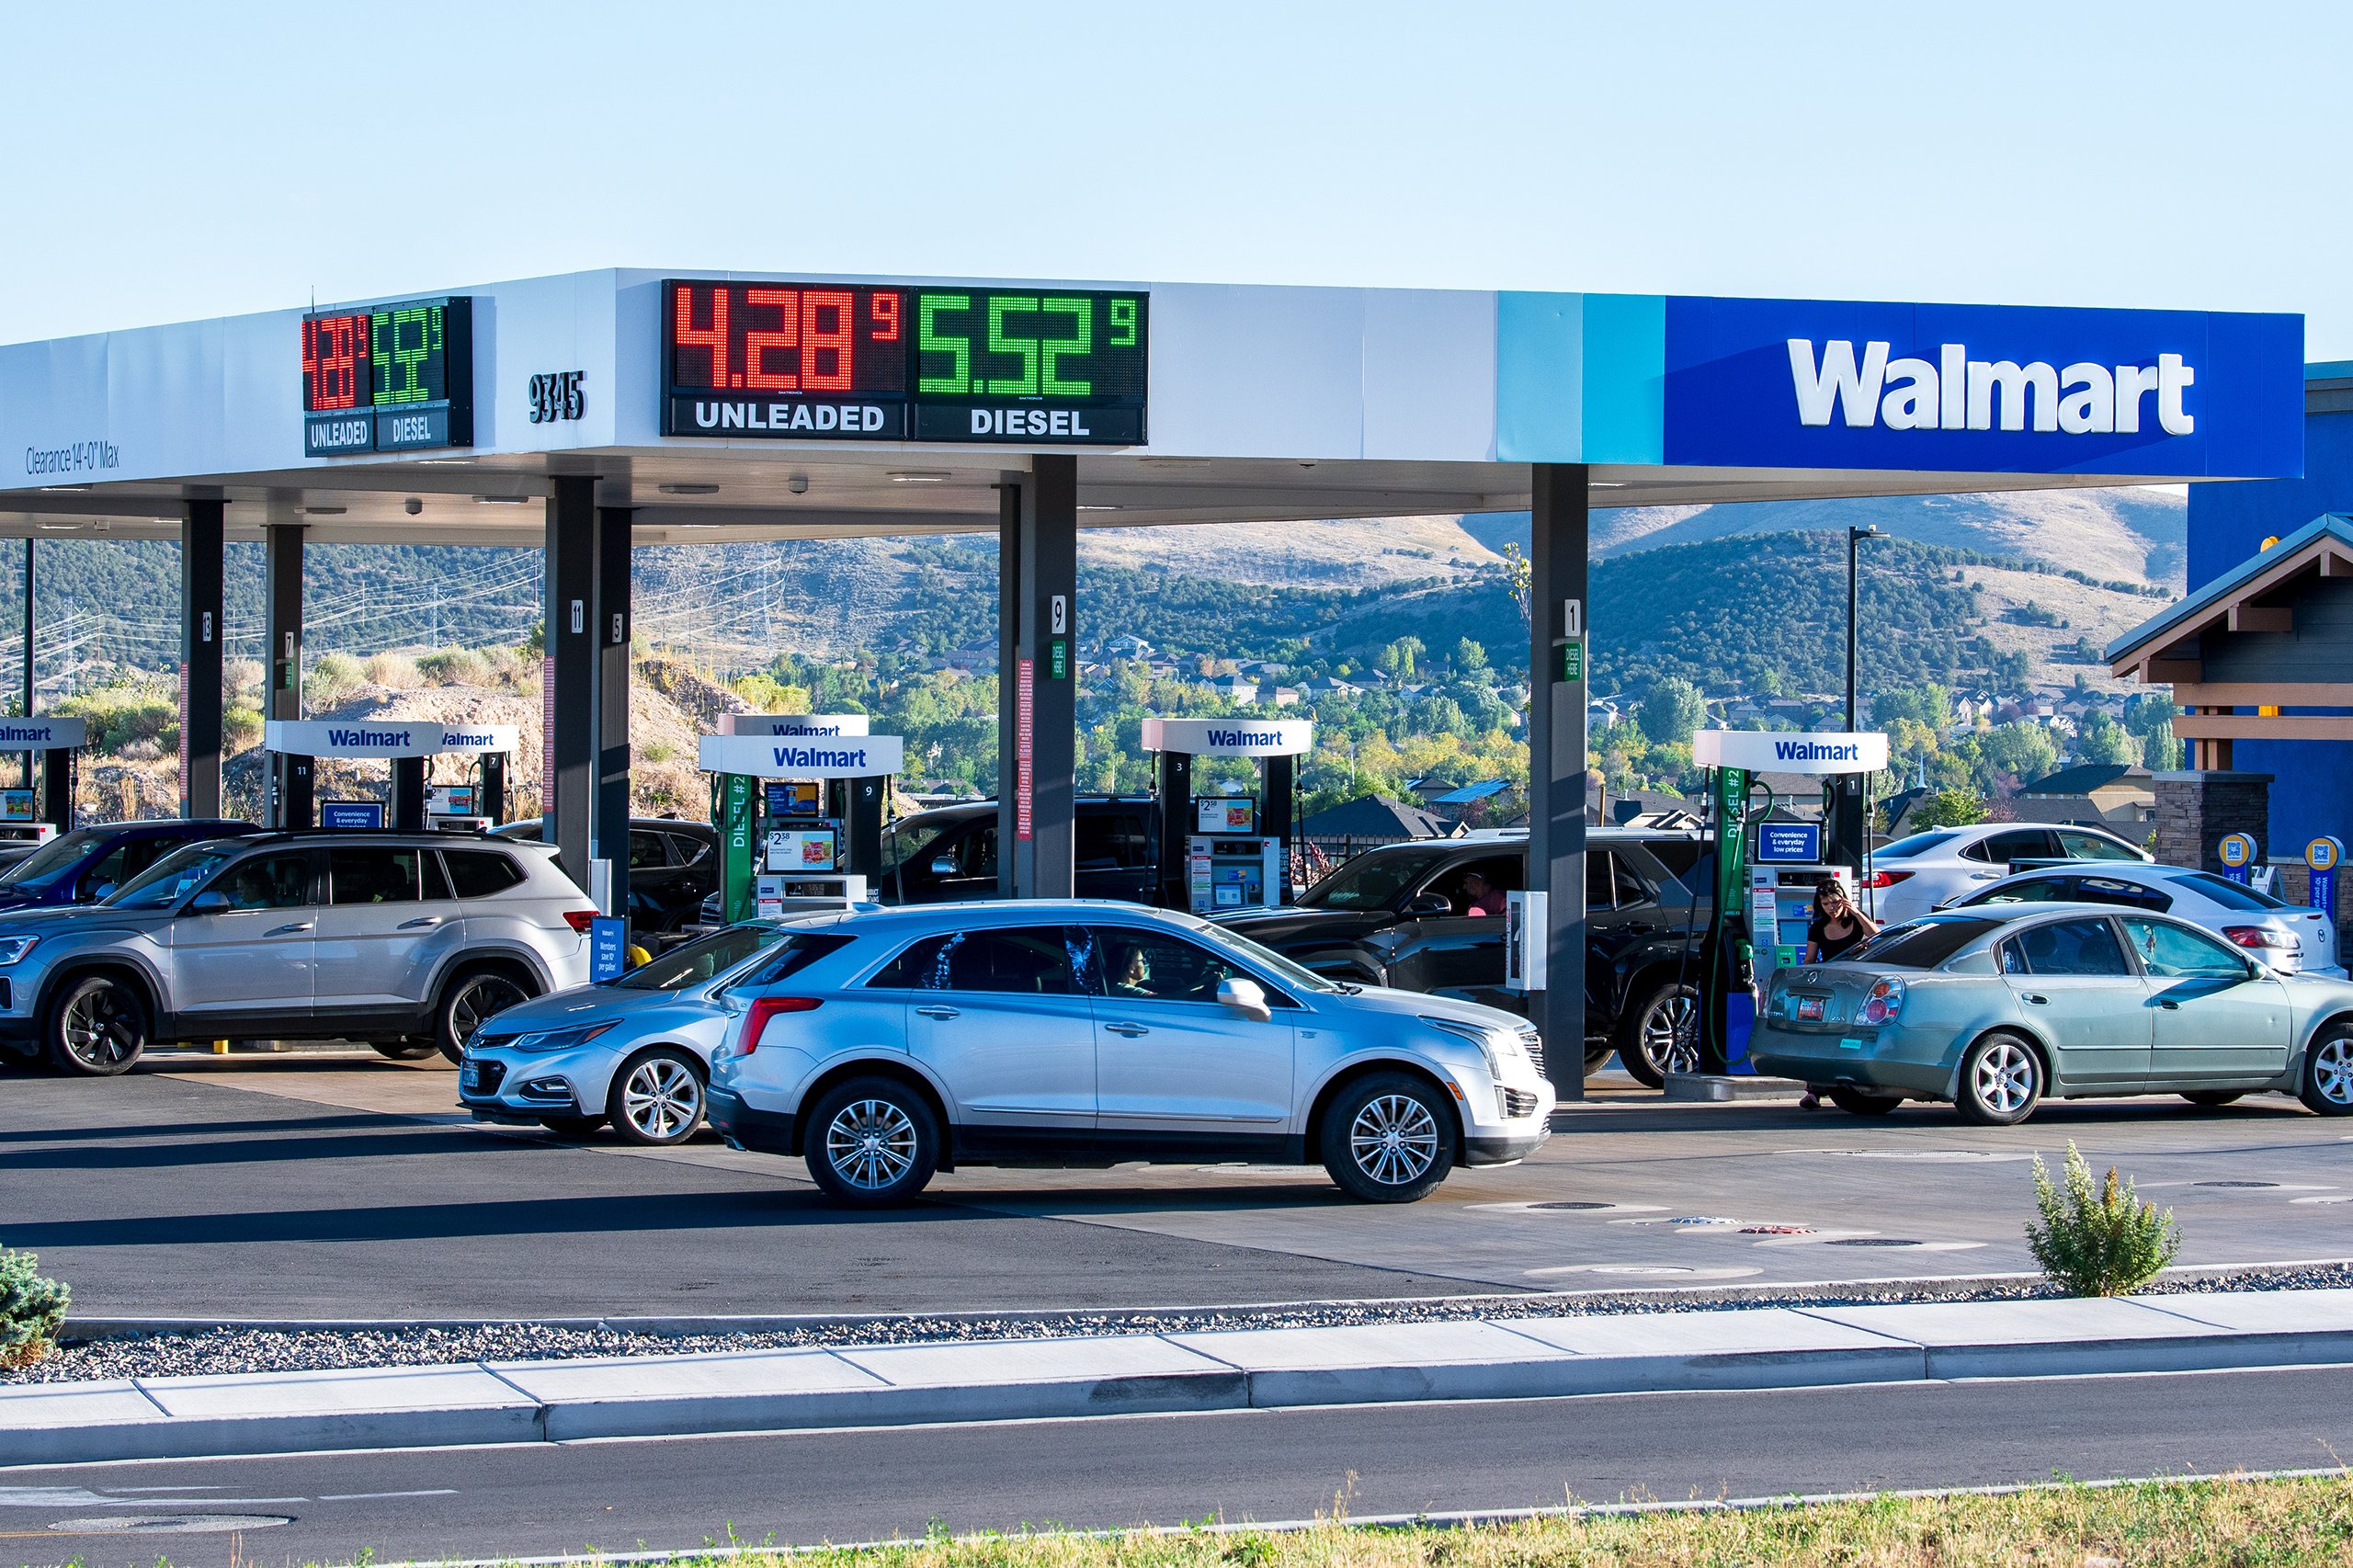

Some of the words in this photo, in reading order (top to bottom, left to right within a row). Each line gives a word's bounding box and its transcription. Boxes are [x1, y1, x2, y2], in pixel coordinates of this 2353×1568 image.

[357, 314, 367, 358] 9
[431, 306, 442, 349] 9
[676, 288, 853, 390] 4.28
[872, 292, 898, 340] 9
[920, 295, 1091, 395] 5.52
[1110, 299, 1136, 346] 9
[529, 369, 585, 424] 9345
[1787, 338, 2195, 436] Walmart
[695, 402, 884, 432] UNLEADED
[971, 409, 1090, 436] DIESEL
[311, 420, 368, 449] UNLEADED
[392, 415, 431, 443] DIESEL
[26, 446, 71, 475] Clearance
[99, 440, 119, 469] Max
[573, 605, 582, 629] 11
[1054, 600, 1063, 629] 9
[1570, 605, 1574, 631] 1
[203, 617, 211, 638] 13
[614, 618, 620, 639] 5
[286, 636, 292, 653] 7
[0, 725, 51, 742] almart
[328, 729, 411, 747] Walmart
[772, 723, 840, 735] Walmart
[1207, 730, 1283, 746] Walmart
[491, 756, 496, 766] 7
[773, 747, 867, 767] Walmart
[1775, 741, 1859, 760] Walmart
[297, 766, 307, 776] 11
[1176, 763, 1183, 771] 3
[733, 776, 745, 793] #2
[1728, 770, 1739, 788] #2
[1850, 779, 1856, 790] 1
[866, 786, 872, 796] 9
[733, 799, 745, 847] DIESEL
[1727, 791, 1739, 838] DIESEL
